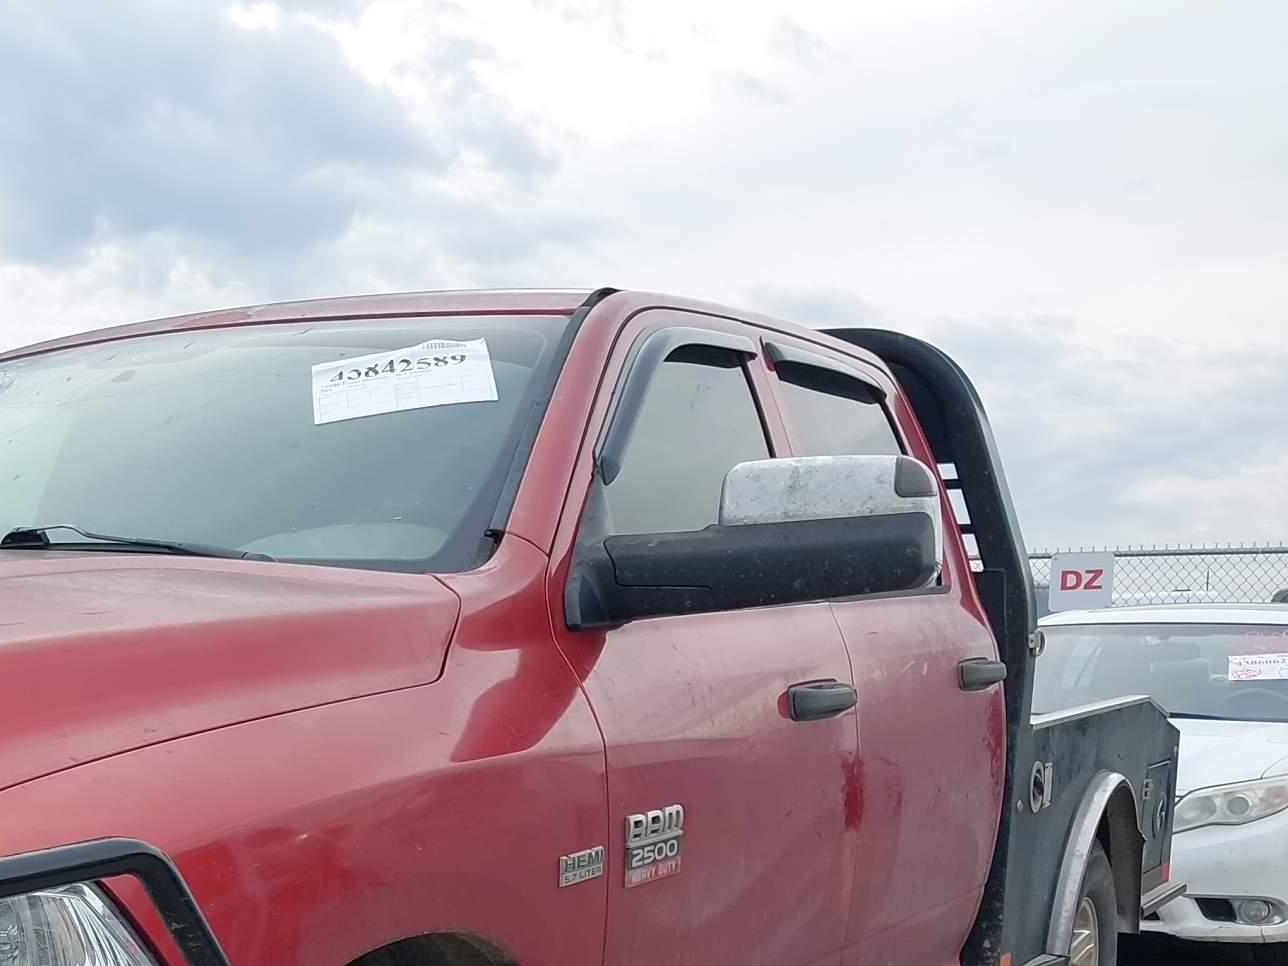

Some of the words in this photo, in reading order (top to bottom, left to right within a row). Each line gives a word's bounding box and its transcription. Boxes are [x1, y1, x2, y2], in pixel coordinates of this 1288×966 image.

[329, 353, 467, 383] 43842589
[1059, 569, 1104, 591] DZ
[626, 804, 684, 843] RAM
[564, 847, 604, 873] HEMI
[631, 839, 678, 868] 2500
[564, 872, 578, 884] 5.7
[579, 866, 602, 880] LITER
[631, 865, 657, 883] HEAVY
[658, 860, 677, 876] DUTY
